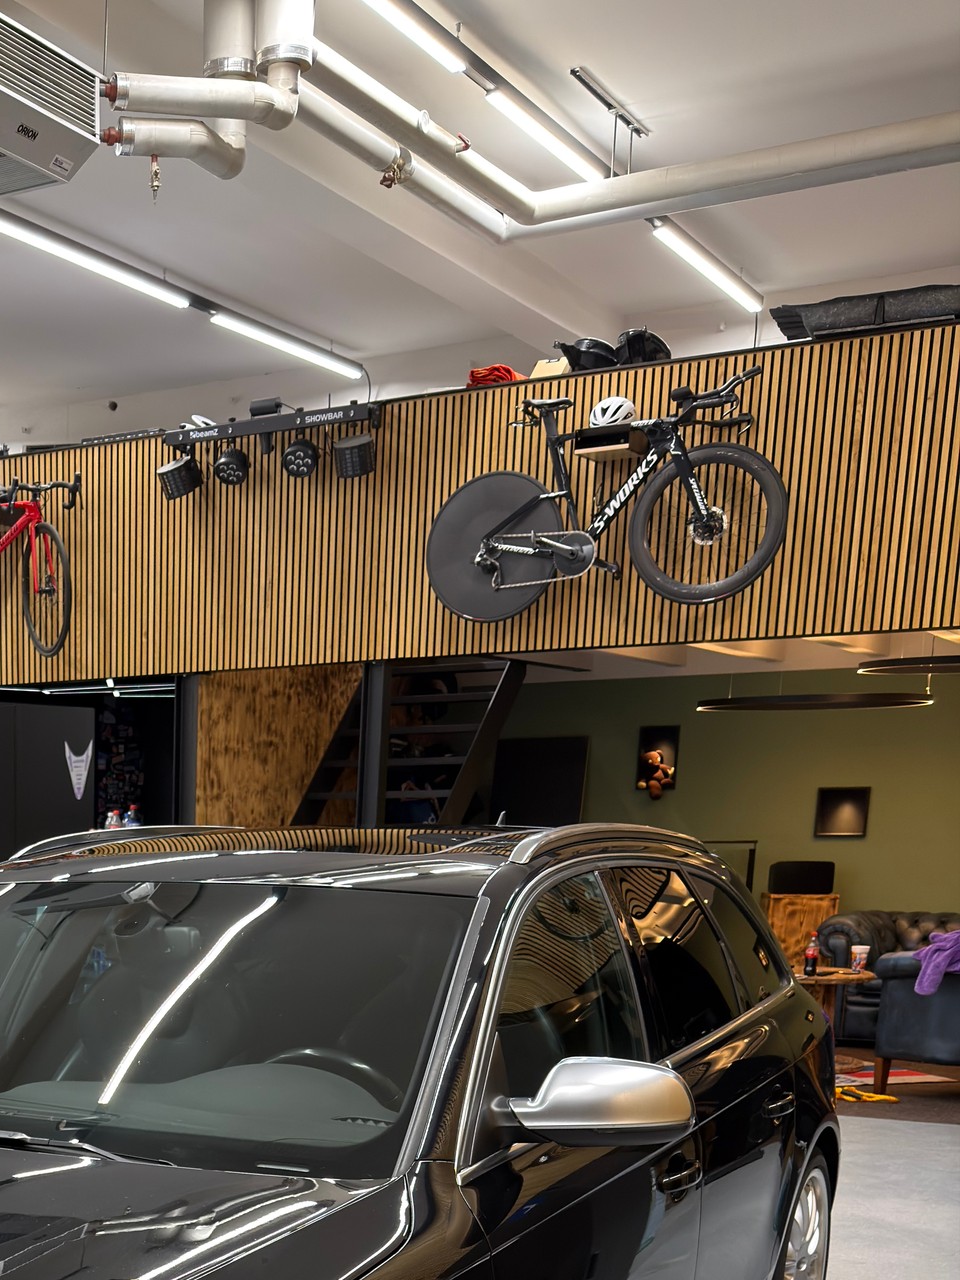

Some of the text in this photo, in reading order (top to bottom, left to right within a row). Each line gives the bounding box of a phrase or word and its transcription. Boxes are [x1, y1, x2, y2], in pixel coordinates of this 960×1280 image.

[16, 124, 39, 141] ORION
[304, 411, 344, 424] SHOWBAR
[593, 448, 658, 535] S-WORKS
